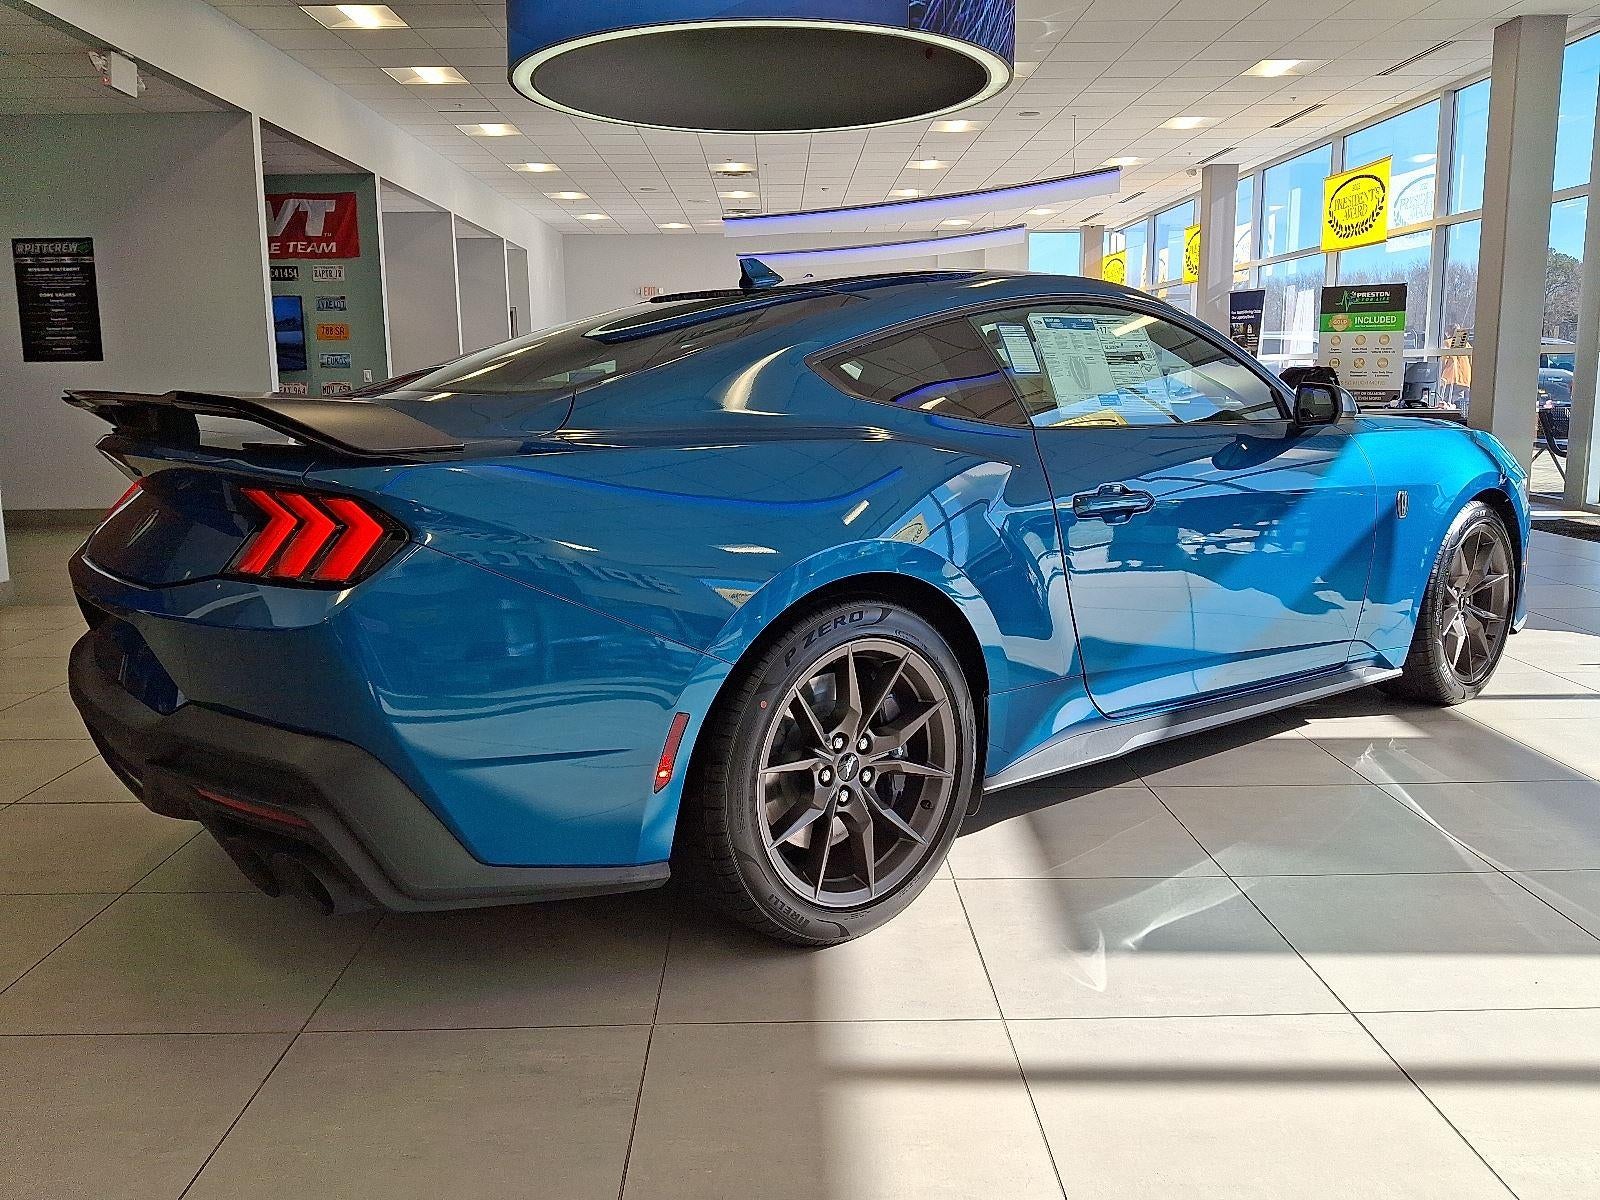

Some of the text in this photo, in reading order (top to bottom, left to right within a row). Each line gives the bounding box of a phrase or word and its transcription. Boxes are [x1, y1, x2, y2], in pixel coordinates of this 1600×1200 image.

[287, 241, 338, 254] TEAM
[1354, 316, 1397, 324] INCLUDED
[784, 646, 797, 667] P
[801, 610, 864, 650] ZERO
